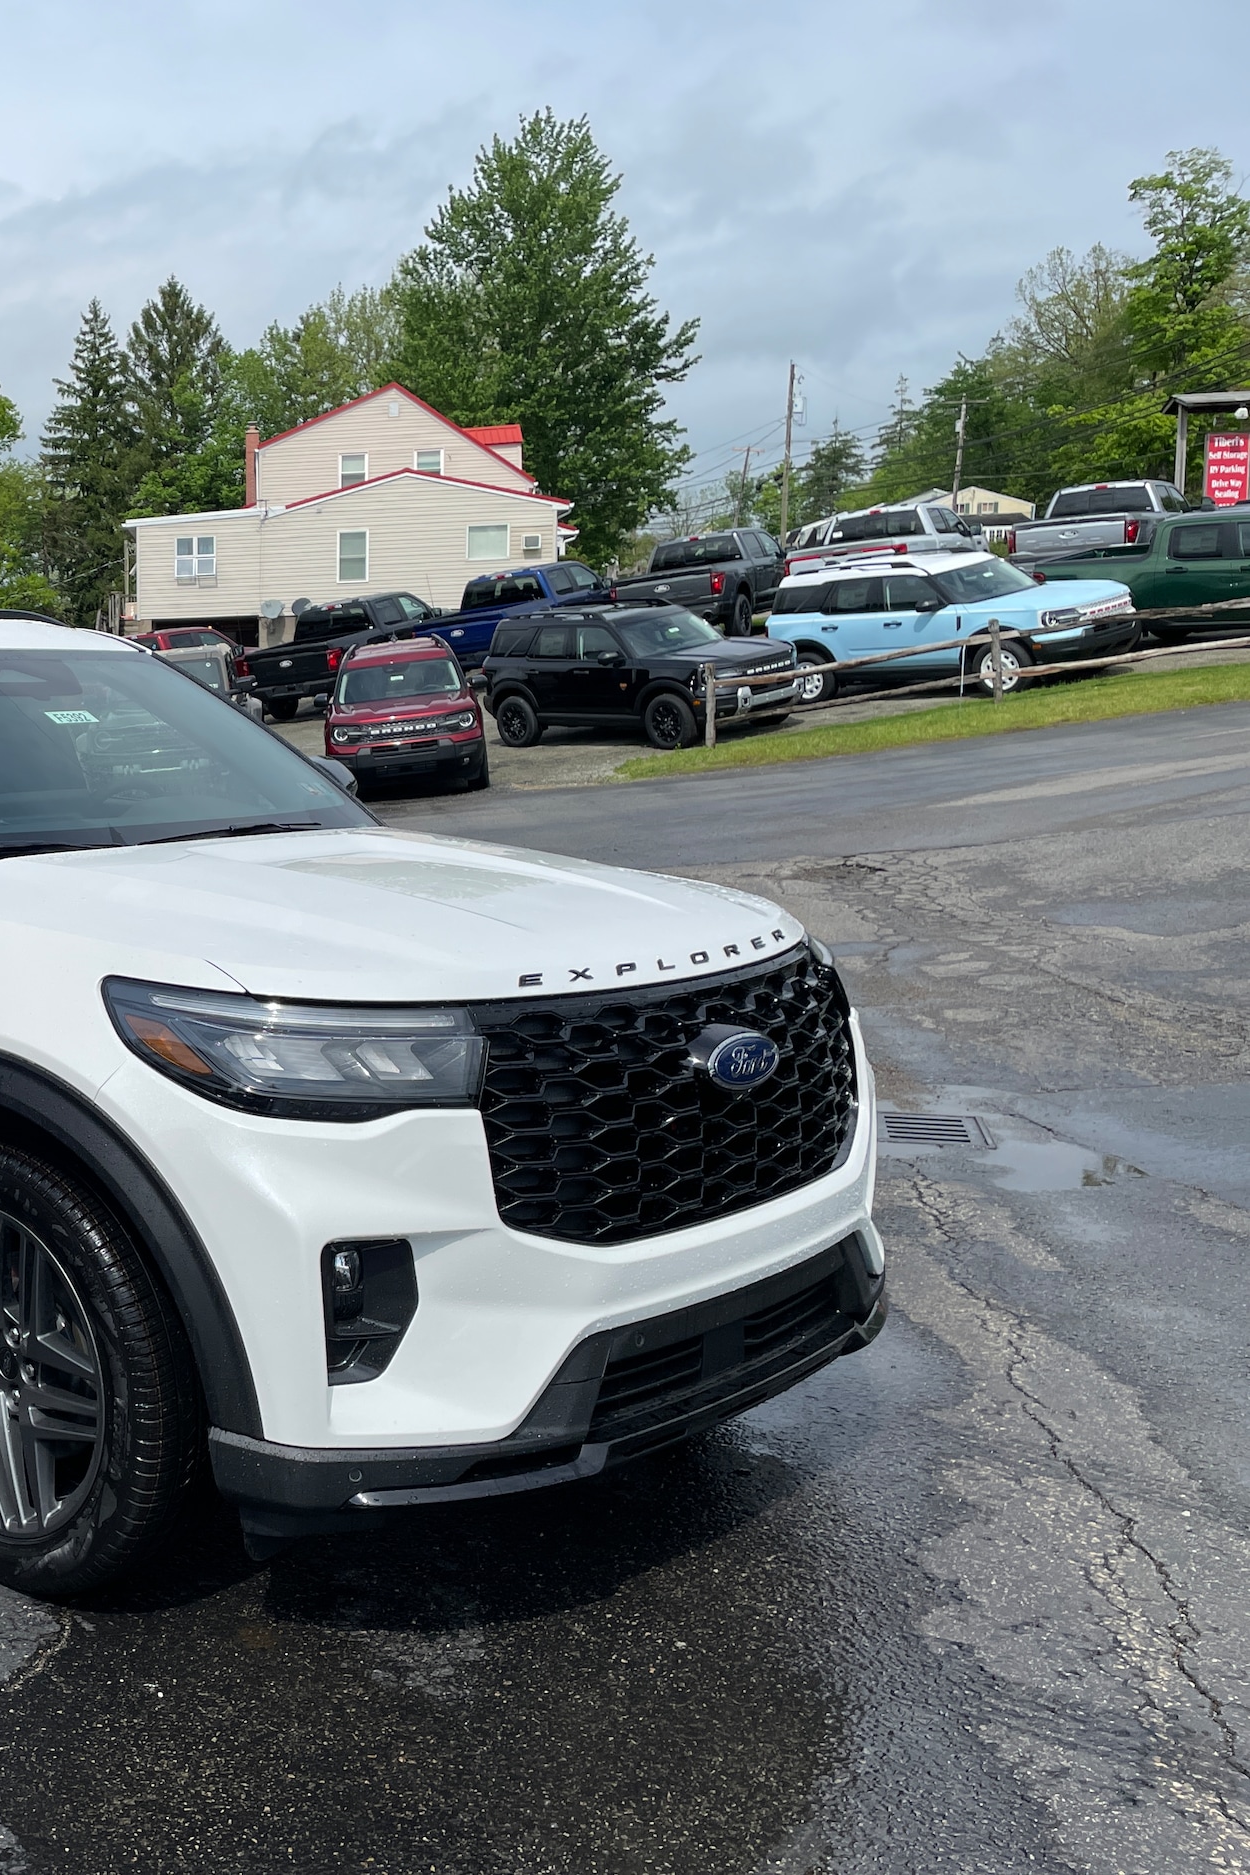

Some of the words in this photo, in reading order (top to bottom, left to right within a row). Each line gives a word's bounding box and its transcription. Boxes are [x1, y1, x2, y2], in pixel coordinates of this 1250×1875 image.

[1209, 451, 1221, 459] Self
[1223, 451, 1248, 460] Storage
[1220, 464, 1246, 474] Parking
[1211, 479, 1229, 488] Drive
[1230, 479, 1243, 488] Way
[1214, 489, 1239, 499] Sealing
[370, 723, 437, 735] BRONCO
[518, 929, 786, 988] EXPLORER
[730, 1044, 773, 1078] Ford
